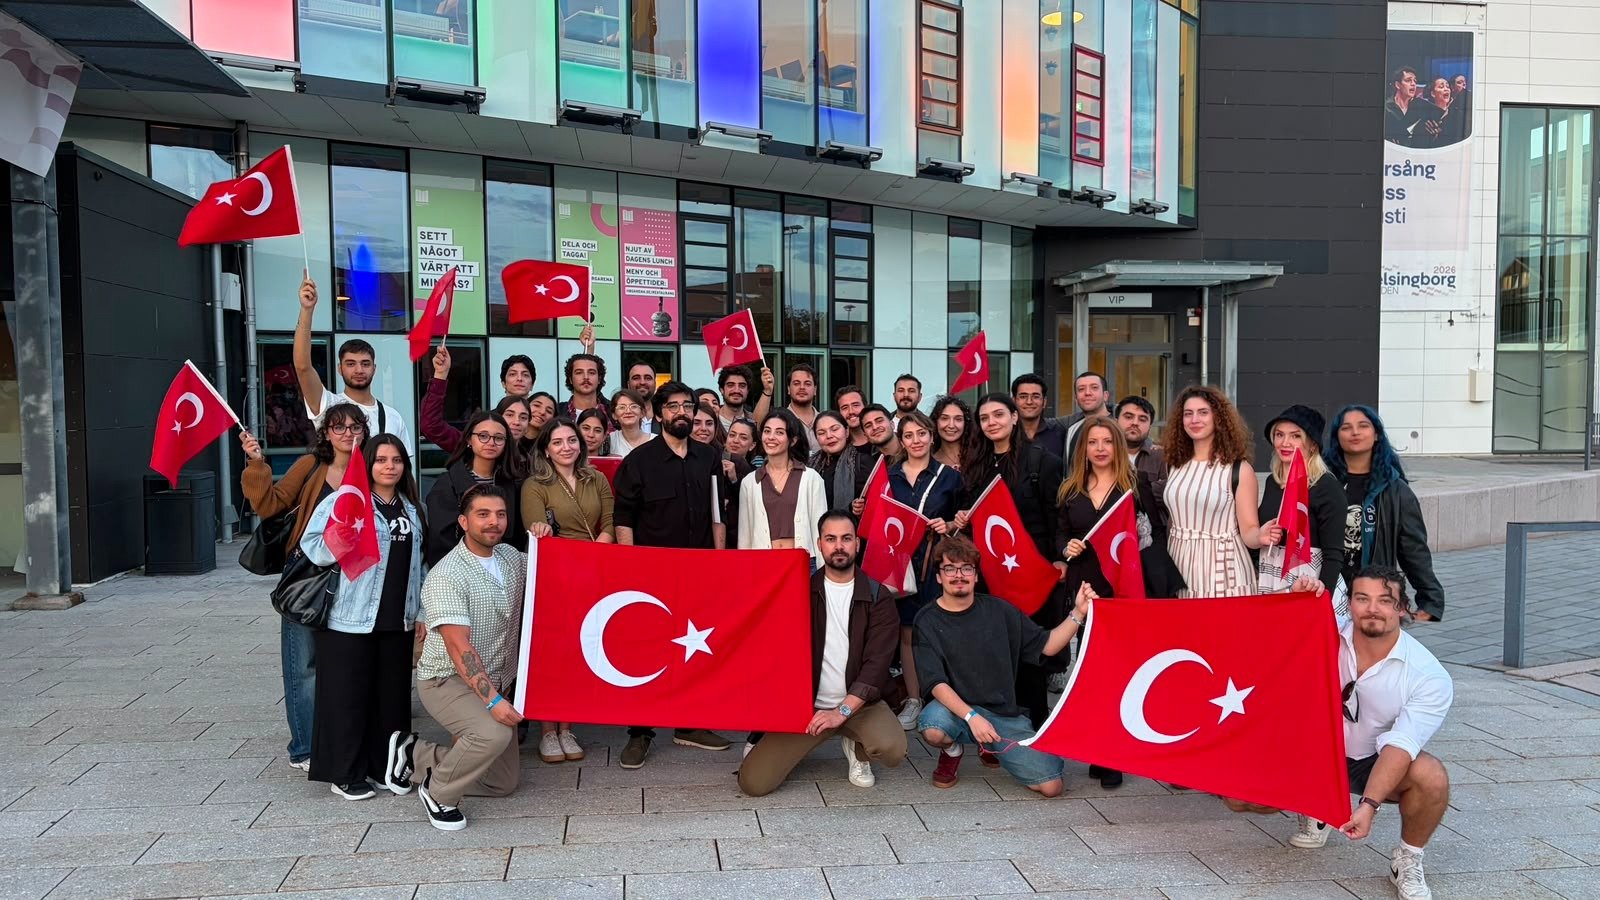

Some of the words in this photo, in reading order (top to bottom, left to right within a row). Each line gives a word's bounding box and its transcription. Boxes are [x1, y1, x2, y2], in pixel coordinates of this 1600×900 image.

[1384, 159, 1436, 181] rsång
[1385, 187, 1406, 200] ss
[1384, 207, 1406, 224] sti
[419, 231, 448, 241] SETT
[562, 240, 580, 248] DELA
[420, 245, 458, 257] NÅGOT
[562, 251, 587, 259] TAGGA!
[625, 255, 651, 264] DAGENS
[652, 257, 673, 265] LUNCH
[420, 260, 450, 272] VÄRT
[454, 264, 474, 274] ATT
[1433, 265, 1456, 274] 2026
[626, 277, 667, 286] ÖPPETTIDER:
[1381, 272, 1456, 289] lsingborg
[1108, 295, 1125, 304] VIP
